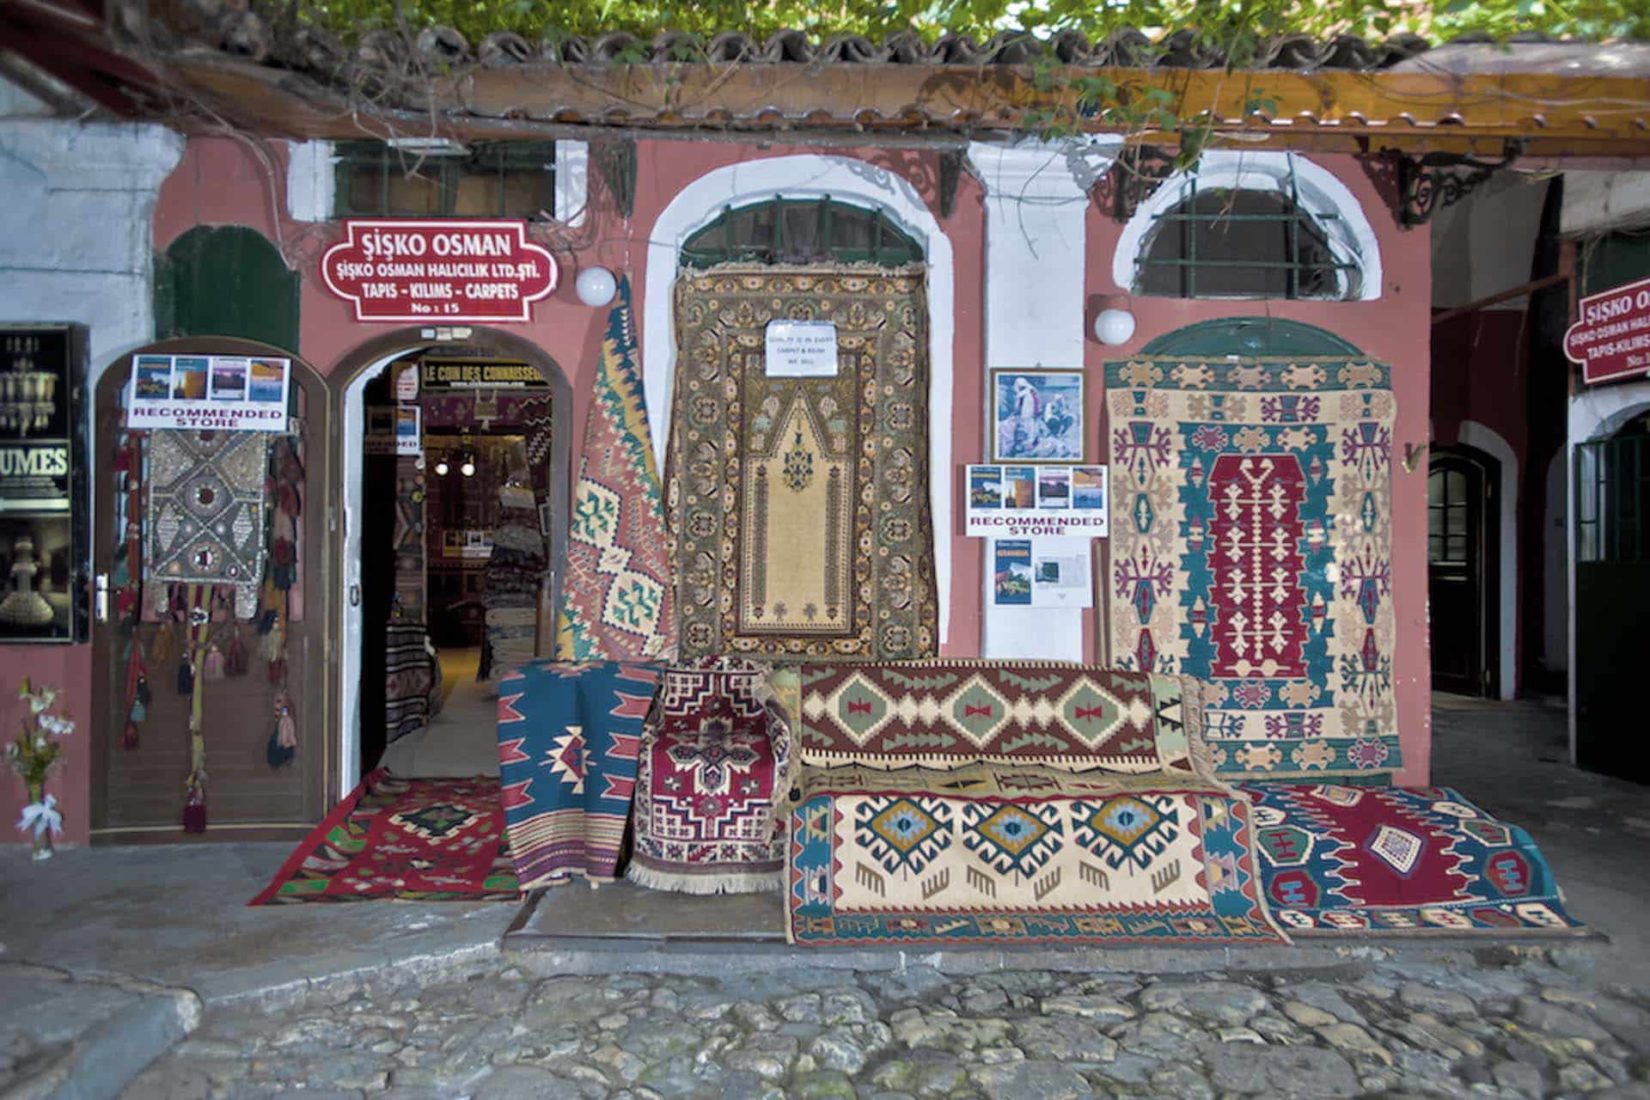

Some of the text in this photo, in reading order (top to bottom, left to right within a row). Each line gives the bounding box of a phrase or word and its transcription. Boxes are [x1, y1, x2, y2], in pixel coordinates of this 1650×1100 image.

[361, 228, 511, 261] ŞİŞKO OSMAN
[336, 260, 374, 280] ŞİŞKO
[377, 262, 425, 278] OSMAN
[427, 262, 490, 278] HALICILIK
[362, 283, 398, 299] TAPIS
[410, 283, 453, 300] KILIMS
[465, 283, 519, 300] CARPETS
[1586, 294, 1632, 326] ŞİŞKO
[424, 366, 437, 381] LE
[133, 407, 282, 420] RECOMMENDED
[176, 417, 239, 428] STORE
[970, 516, 1105, 526] RECOMMENDED
[1009, 526, 1066, 535] STORE
